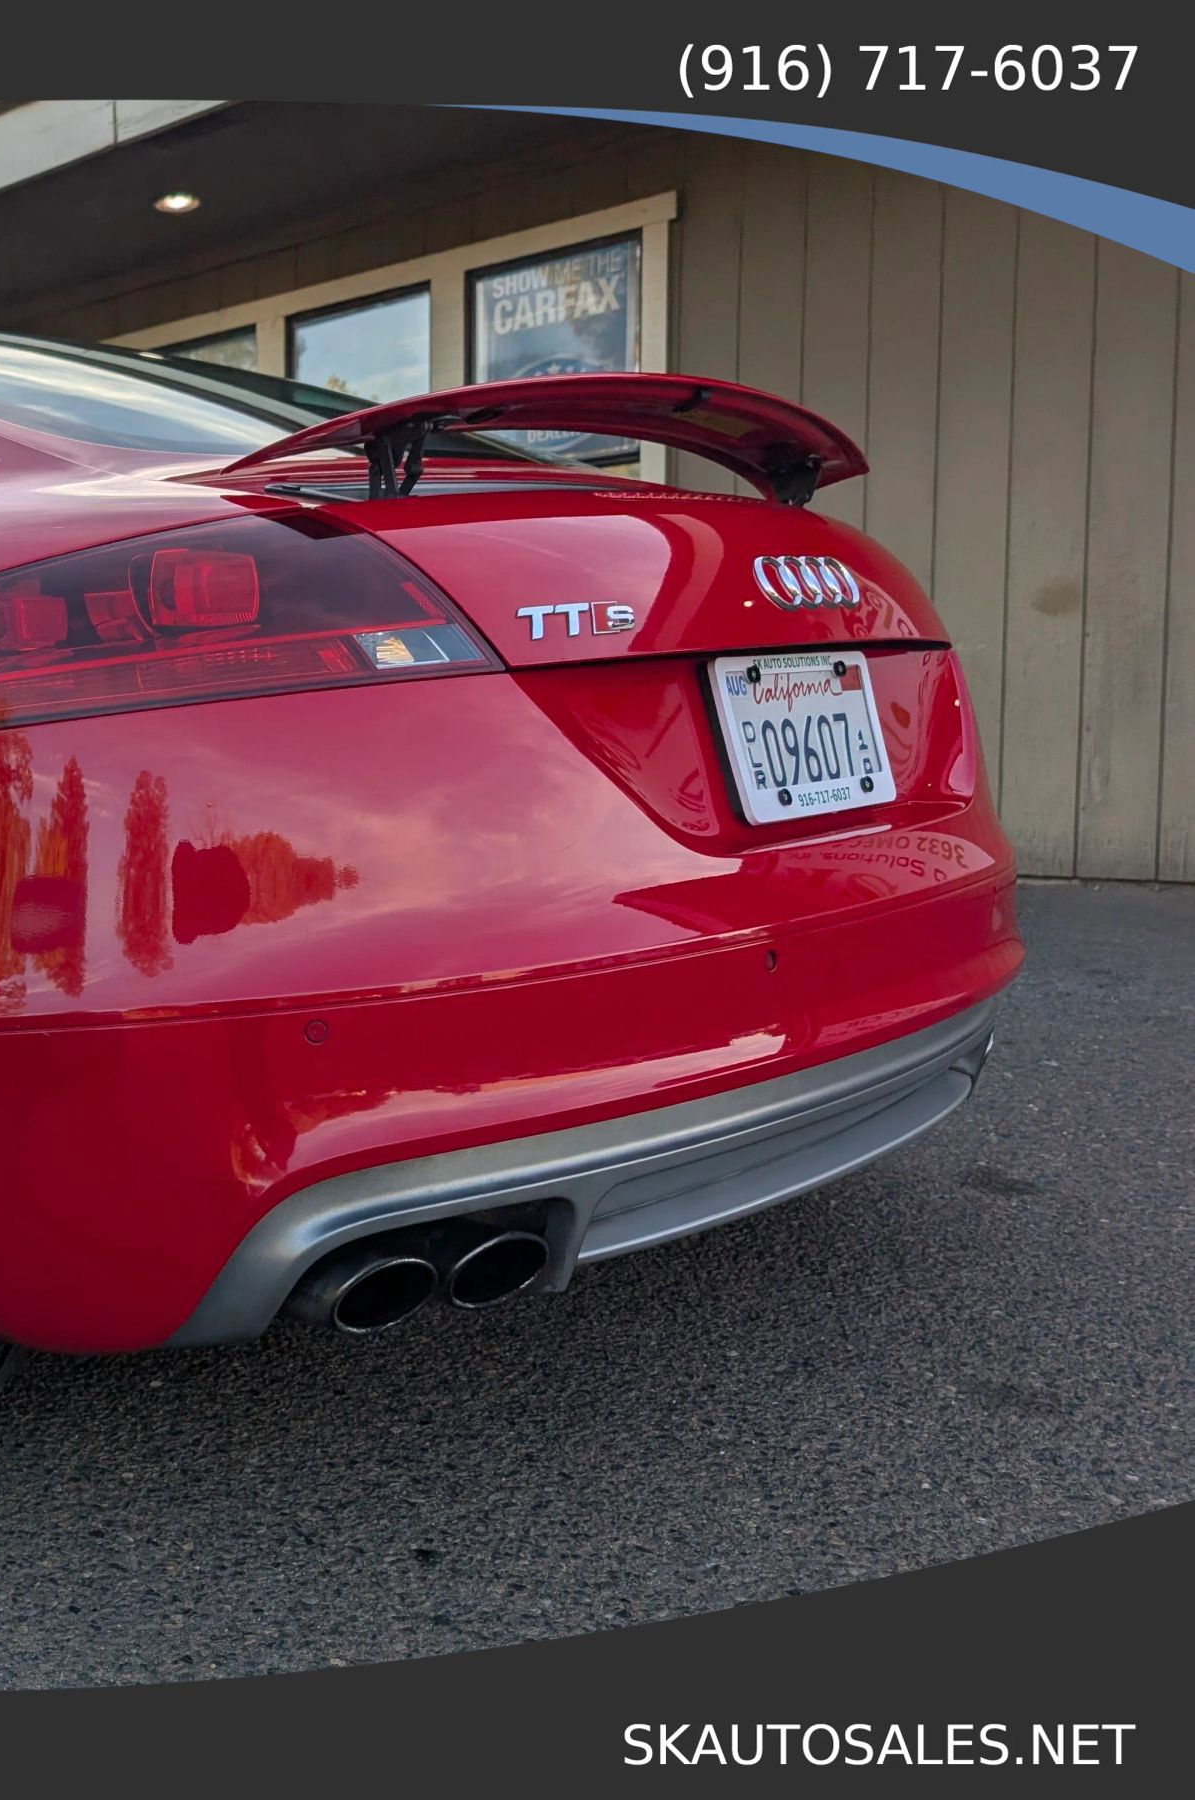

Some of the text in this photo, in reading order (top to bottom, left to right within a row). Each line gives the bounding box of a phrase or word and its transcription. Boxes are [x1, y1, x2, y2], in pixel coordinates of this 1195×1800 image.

[492, 248, 623, 299] SHOW ME THE
[492, 275, 621, 336] CARFAX
[515, 601, 636, 640] TTS
[763, 657, 782, 669] AUTO
[783, 655, 820, 668] SOLUTIONS
[820, 655, 833, 666] INC
[725, 674, 748, 697] AUG
[752, 672, 843, 712] California
[761, 712, 855, 788] 09607
[798, 786, 851, 807] 916-717-6037
[916, 836, 969, 870] 3632
